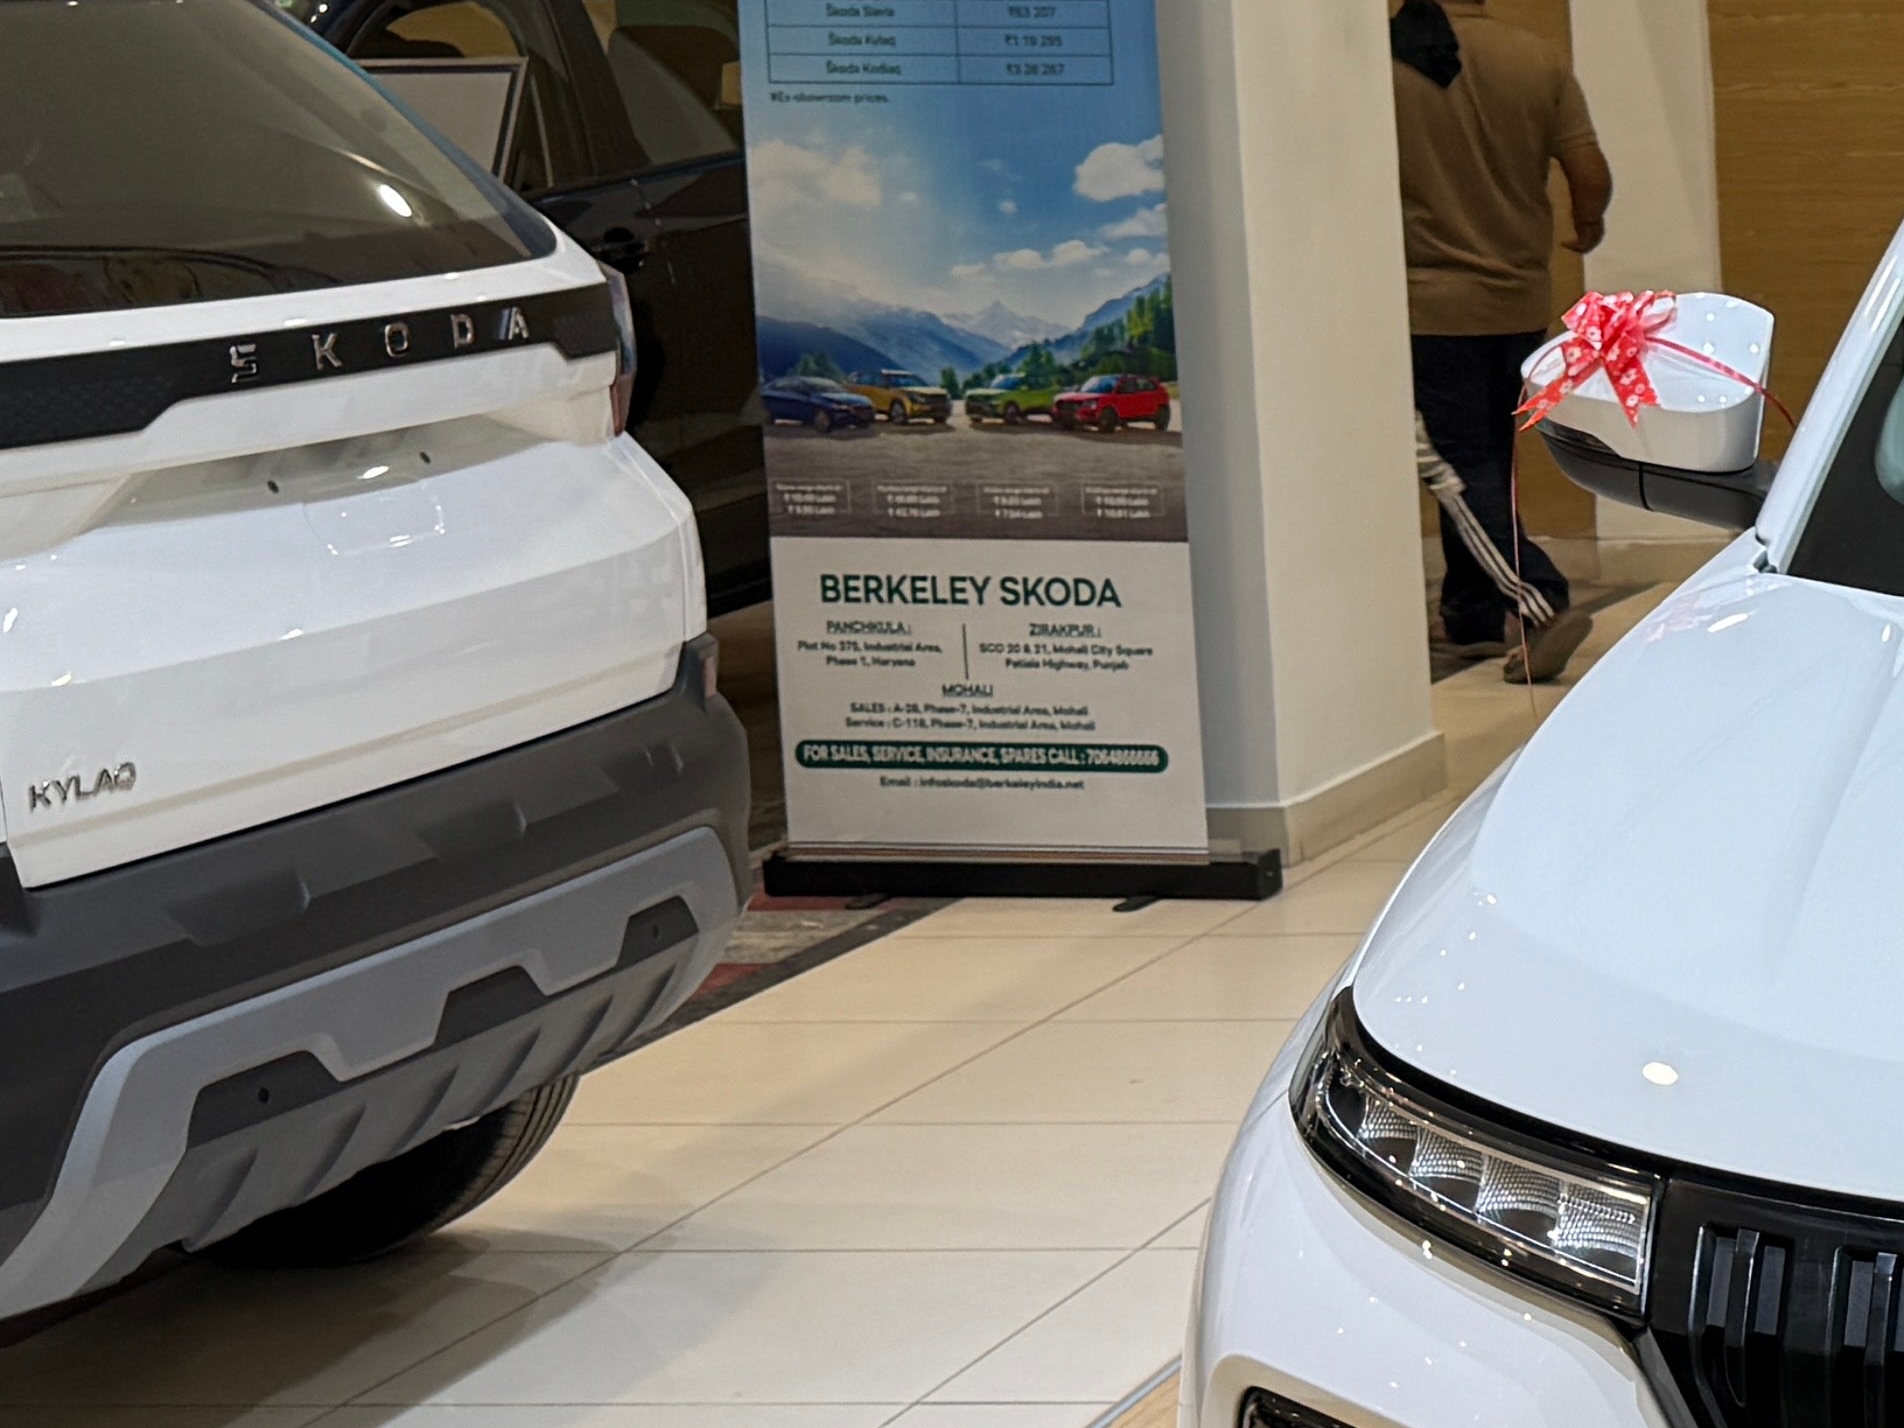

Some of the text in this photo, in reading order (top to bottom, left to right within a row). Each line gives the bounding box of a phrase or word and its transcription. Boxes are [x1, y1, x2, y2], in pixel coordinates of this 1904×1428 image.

[229, 307, 530, 384] SKODA
[820, 573, 1122, 608] BERKELEY SKODA
[1091, 645, 1112, 657] City
[1116, 645, 1153, 657] Square
[1093, 660, 1129, 672] Punjab
[972, 705, 1021, 716] Industrial
[1023, 706, 1050, 716] Area,
[1053, 706, 1088, 716] Mohali
[979, 721, 1028, 731] Industrial
[1030, 721, 1058, 732] Area,
[1060, 722, 1095, 731] Mohali
[803, 745, 828, 760] FOR
[830, 745, 871, 763] SALES,
[926, 747, 999, 765] INSURANCE,
[1000, 748, 1046, 764] SPARES
[1048, 749, 1079, 764] CALL
[880, 776, 911, 787] Email
